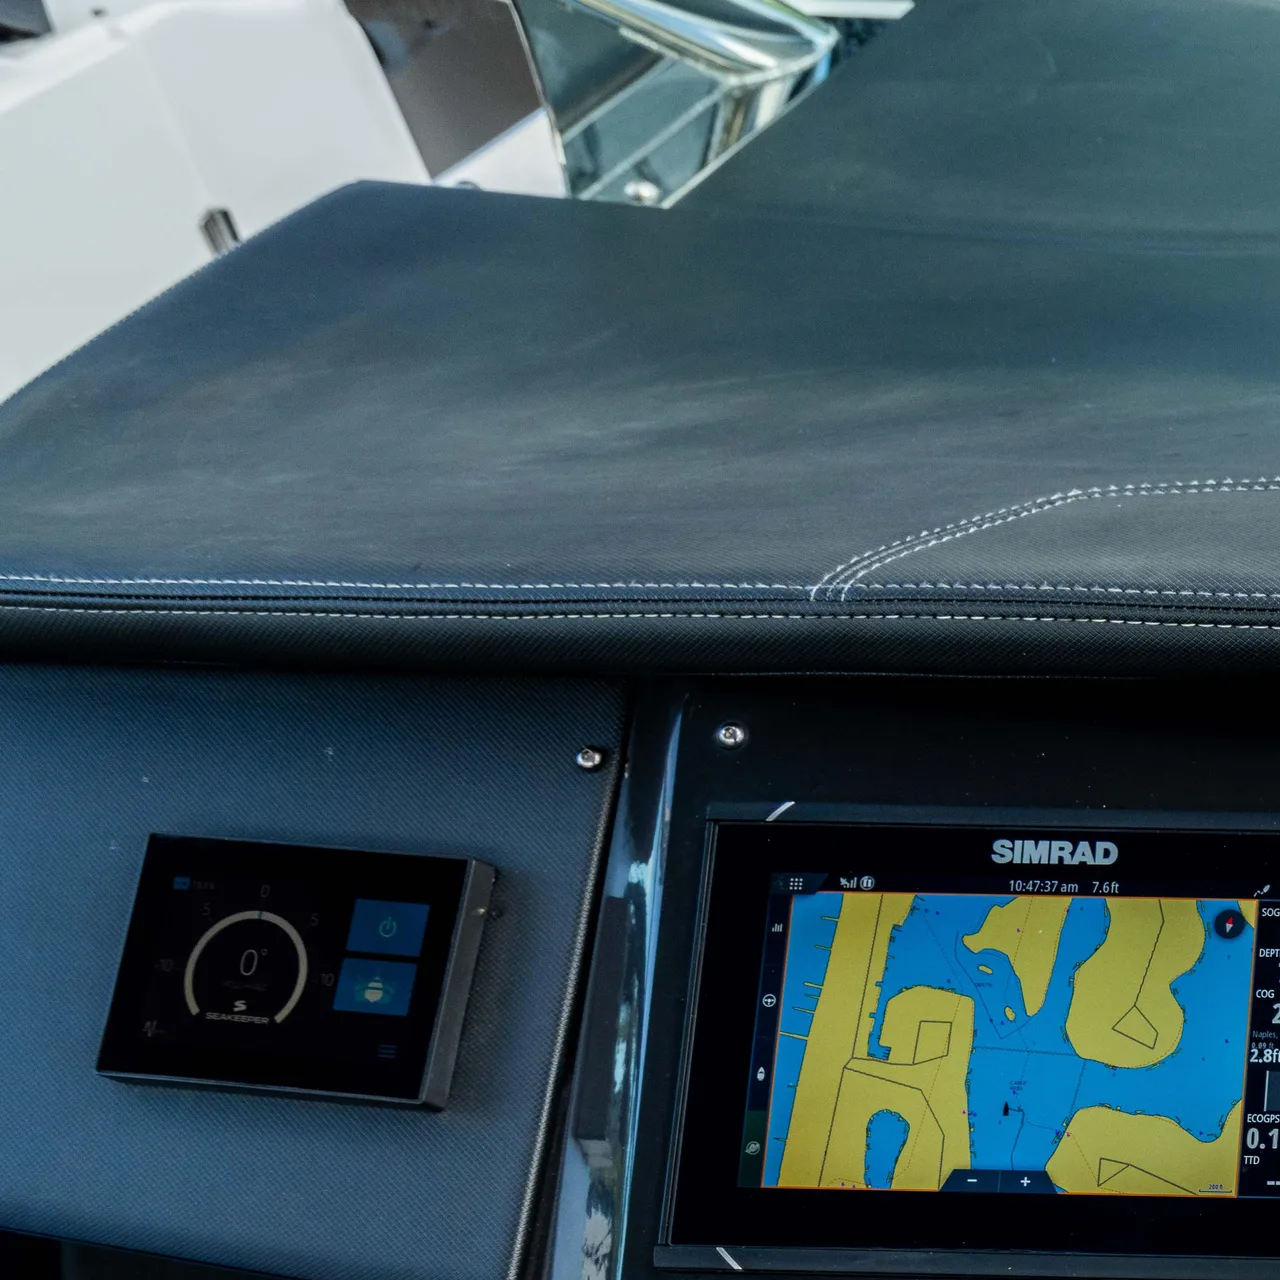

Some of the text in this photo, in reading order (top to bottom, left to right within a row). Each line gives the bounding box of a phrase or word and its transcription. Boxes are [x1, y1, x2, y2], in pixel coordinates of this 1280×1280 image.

[991, 840, 1119, 865] SIMRAD
[1009, 880, 1058, 892] 10:47:37
[1060, 882, 1079, 893] am
[1262, 908, 1280, 917] SOG
[1256, 989, 1275, 998] COG
[205, 1012, 270, 1024] SEAKEEPER
[1247, 1114, 1280, 1123] ECOGPS
[1244, 1155, 1260, 1165] TTD
